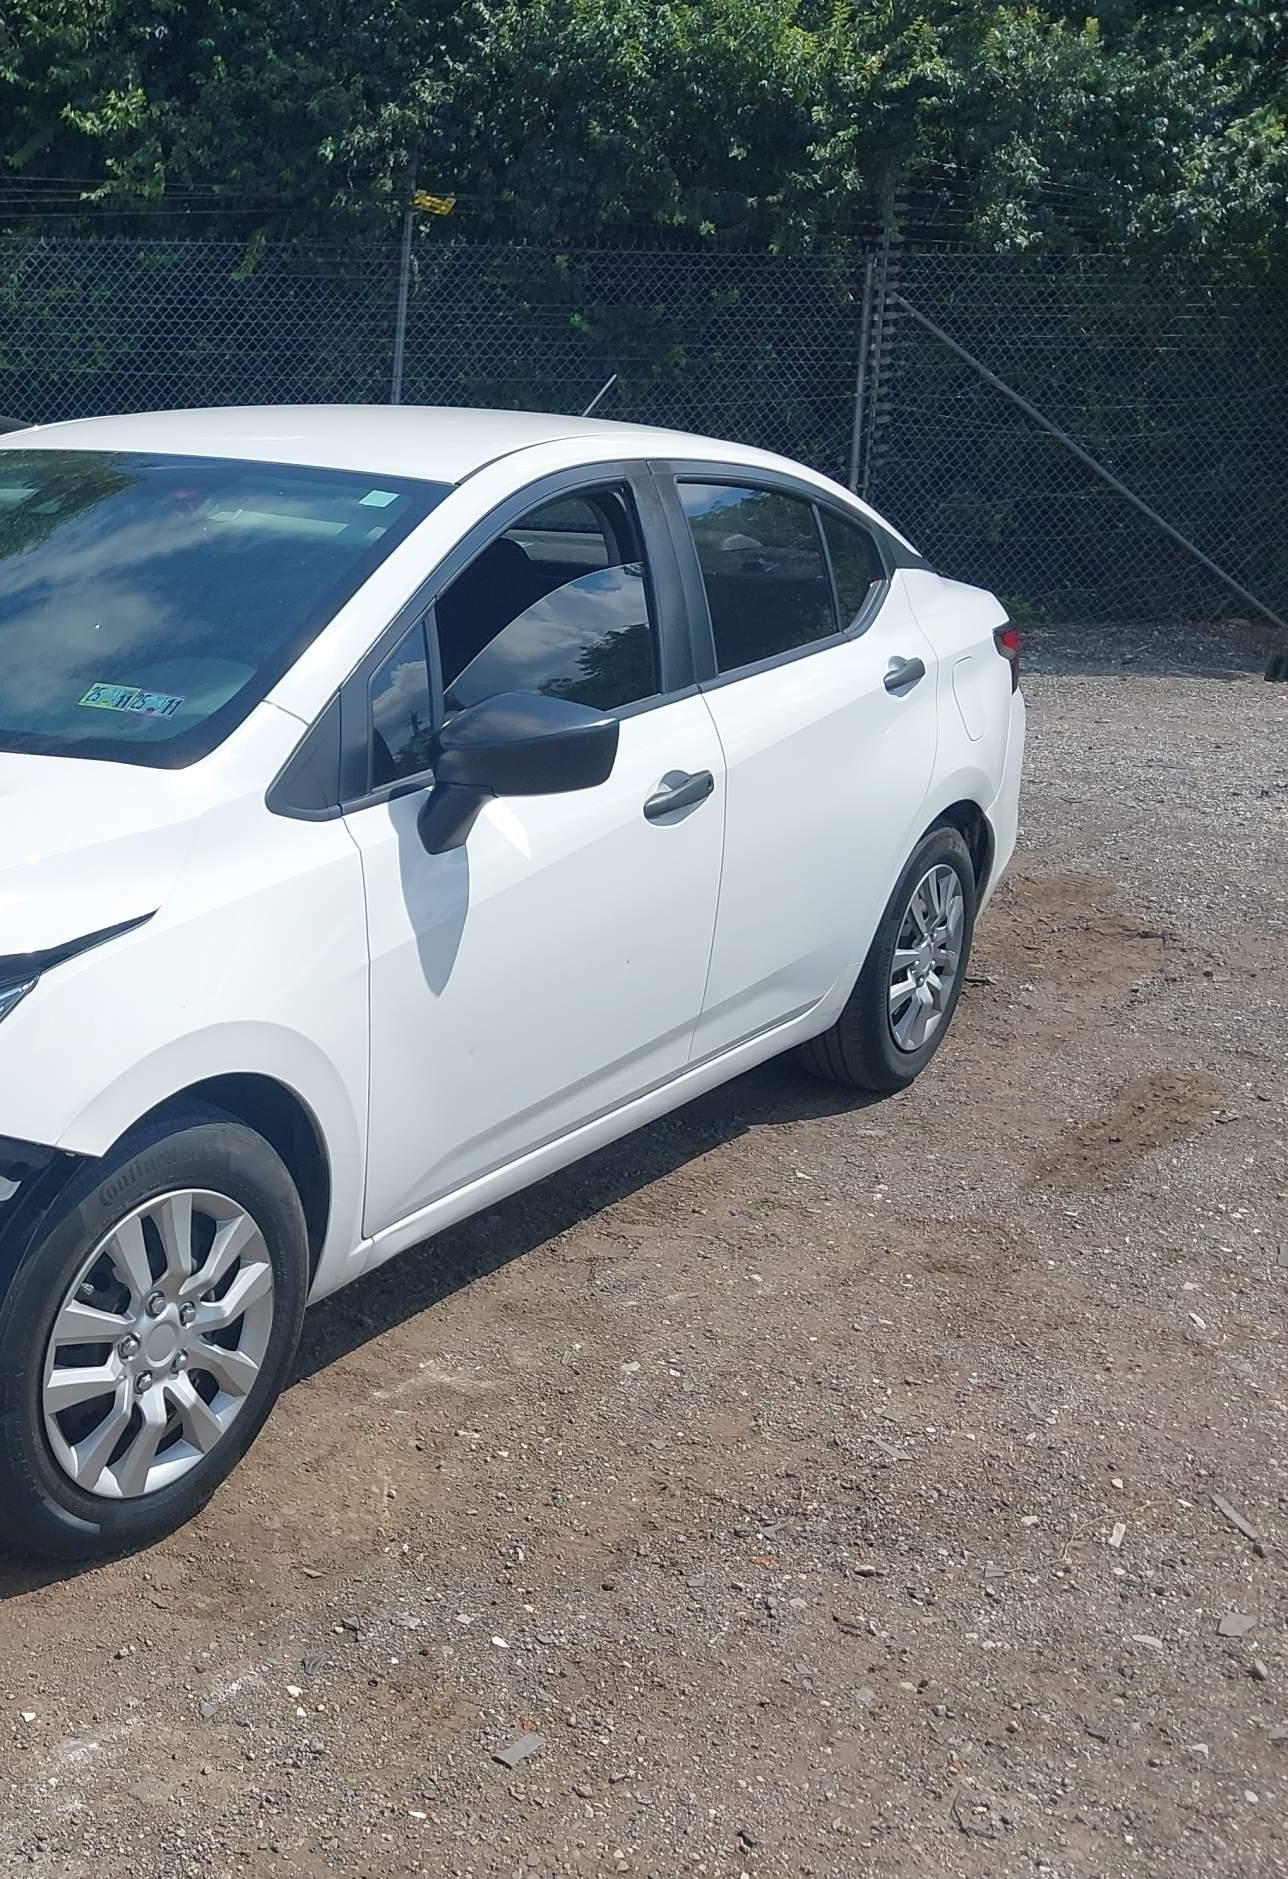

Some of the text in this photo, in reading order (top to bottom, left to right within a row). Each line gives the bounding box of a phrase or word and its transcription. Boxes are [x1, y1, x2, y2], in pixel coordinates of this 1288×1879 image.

[87, 686, 133, 709] 25 11
[132, 692, 182, 715] 25 11
